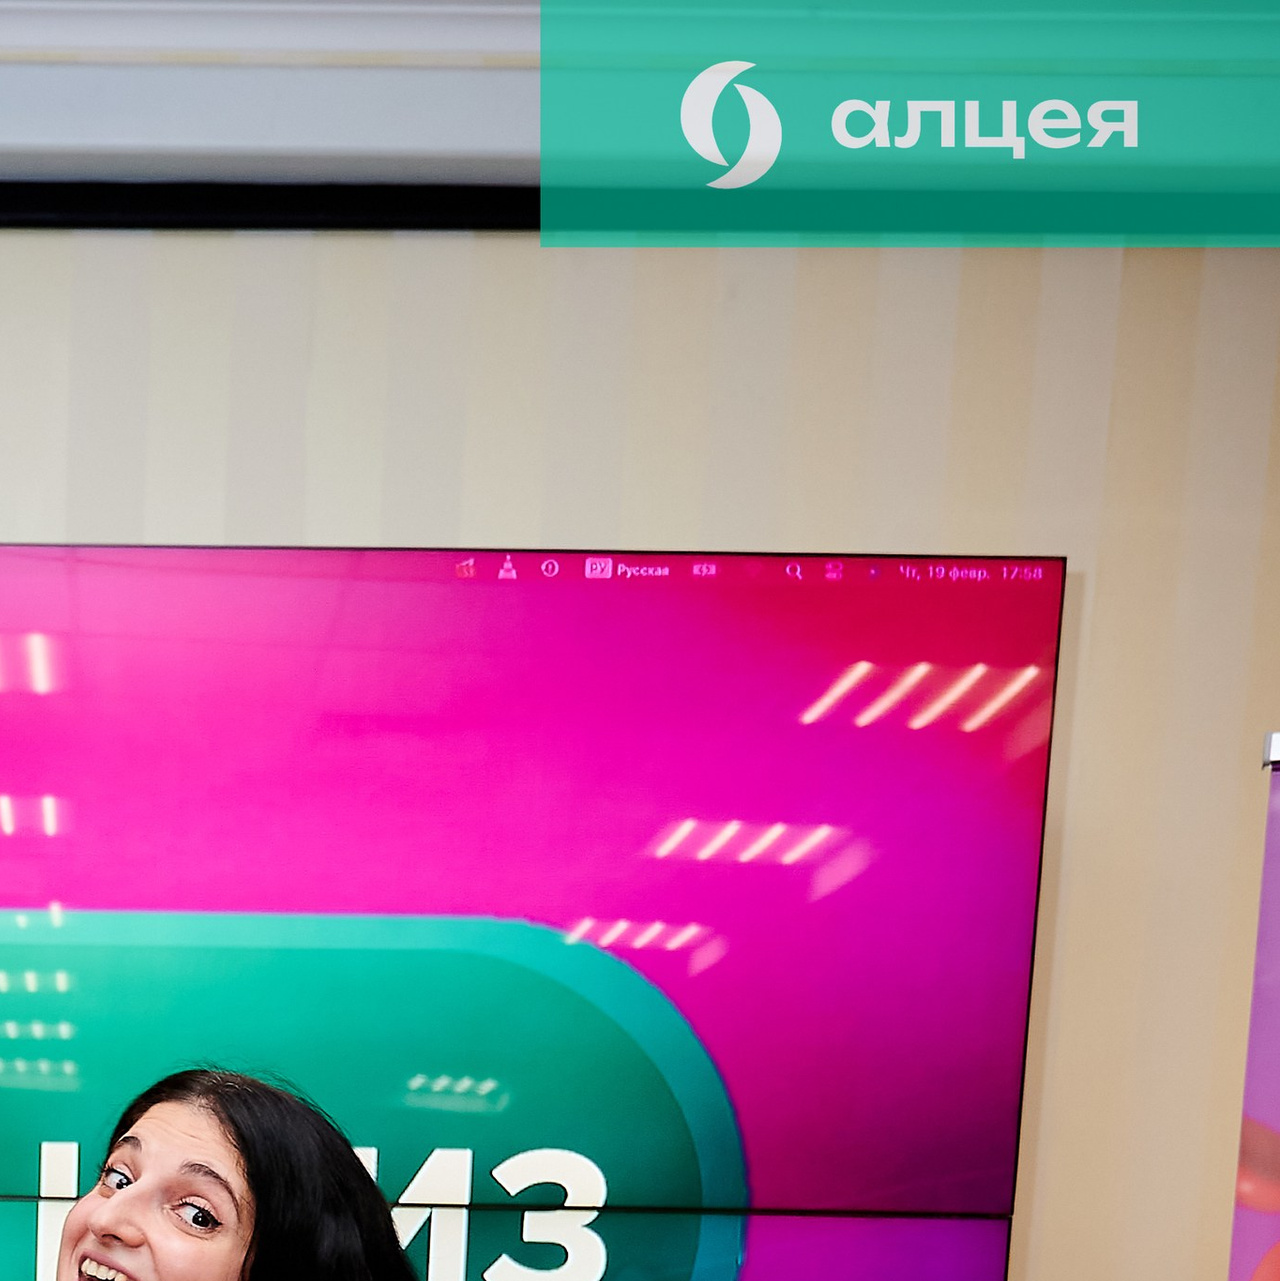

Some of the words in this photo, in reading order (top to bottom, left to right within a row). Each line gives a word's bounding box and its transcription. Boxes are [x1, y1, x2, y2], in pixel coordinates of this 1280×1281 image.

[617, 563, 670, 578] Русская
[928, 565, 945, 580] 19
[948, 565, 990, 582] февр.
